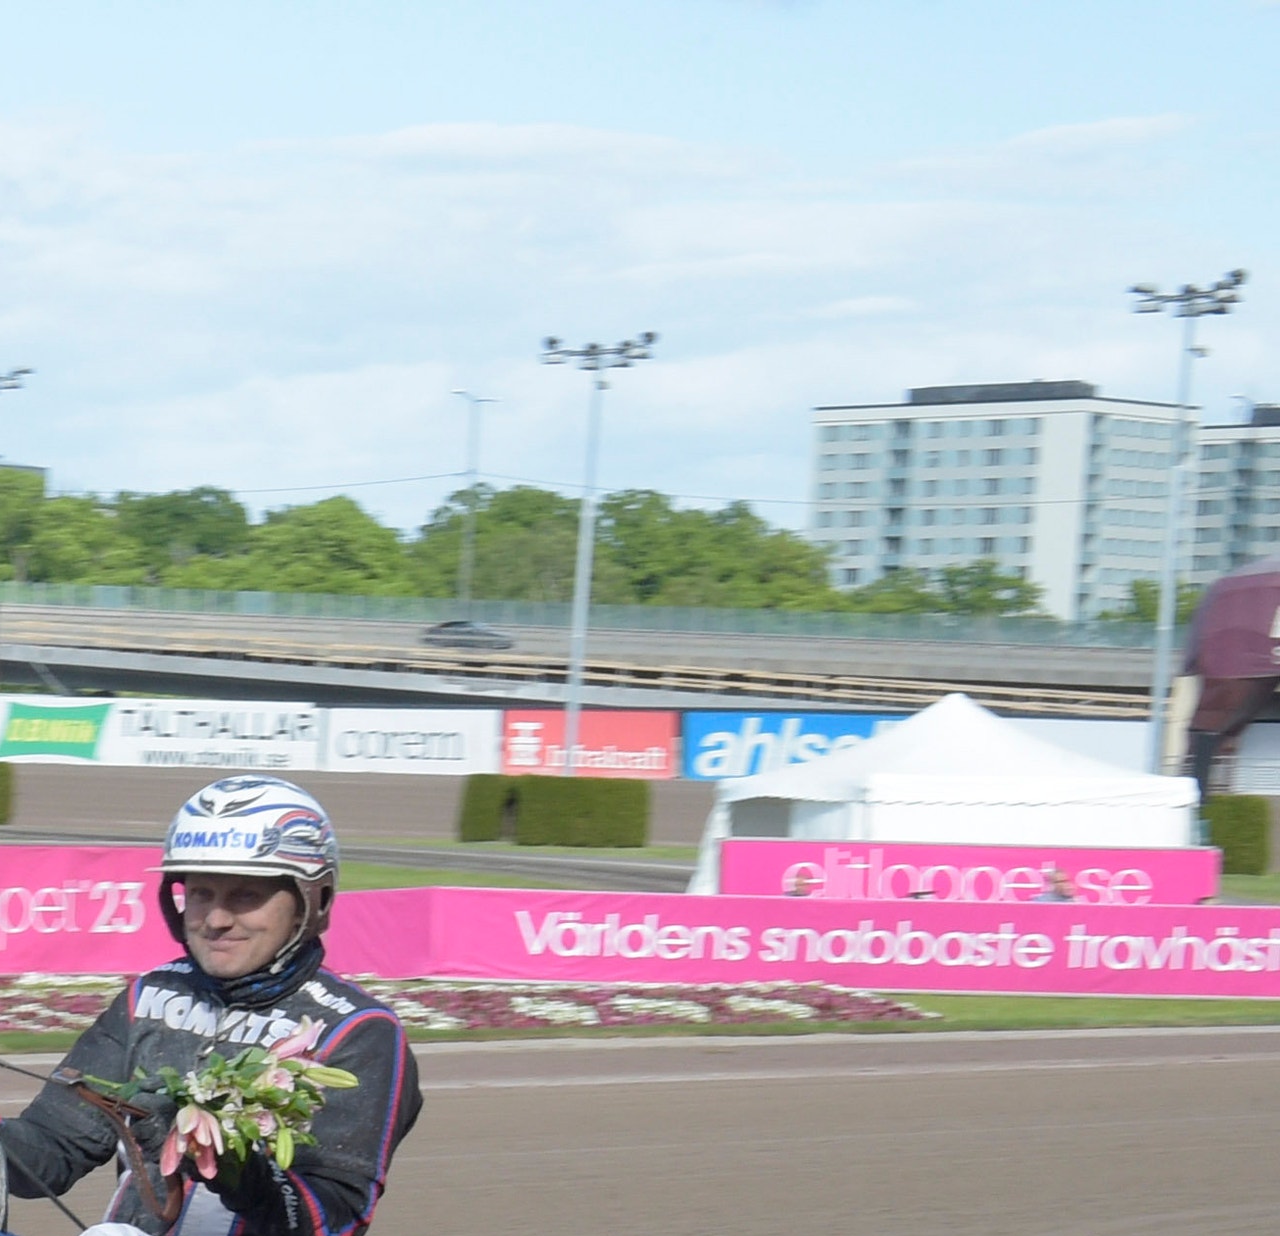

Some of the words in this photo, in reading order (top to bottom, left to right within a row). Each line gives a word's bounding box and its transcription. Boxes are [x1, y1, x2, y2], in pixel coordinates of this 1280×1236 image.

[174, 828, 259, 849] KOMATSU
[91, 881, 147, 934] 23
[514, 911, 751, 964] Världens
[759, 919, 1054, 970] snabbaste
